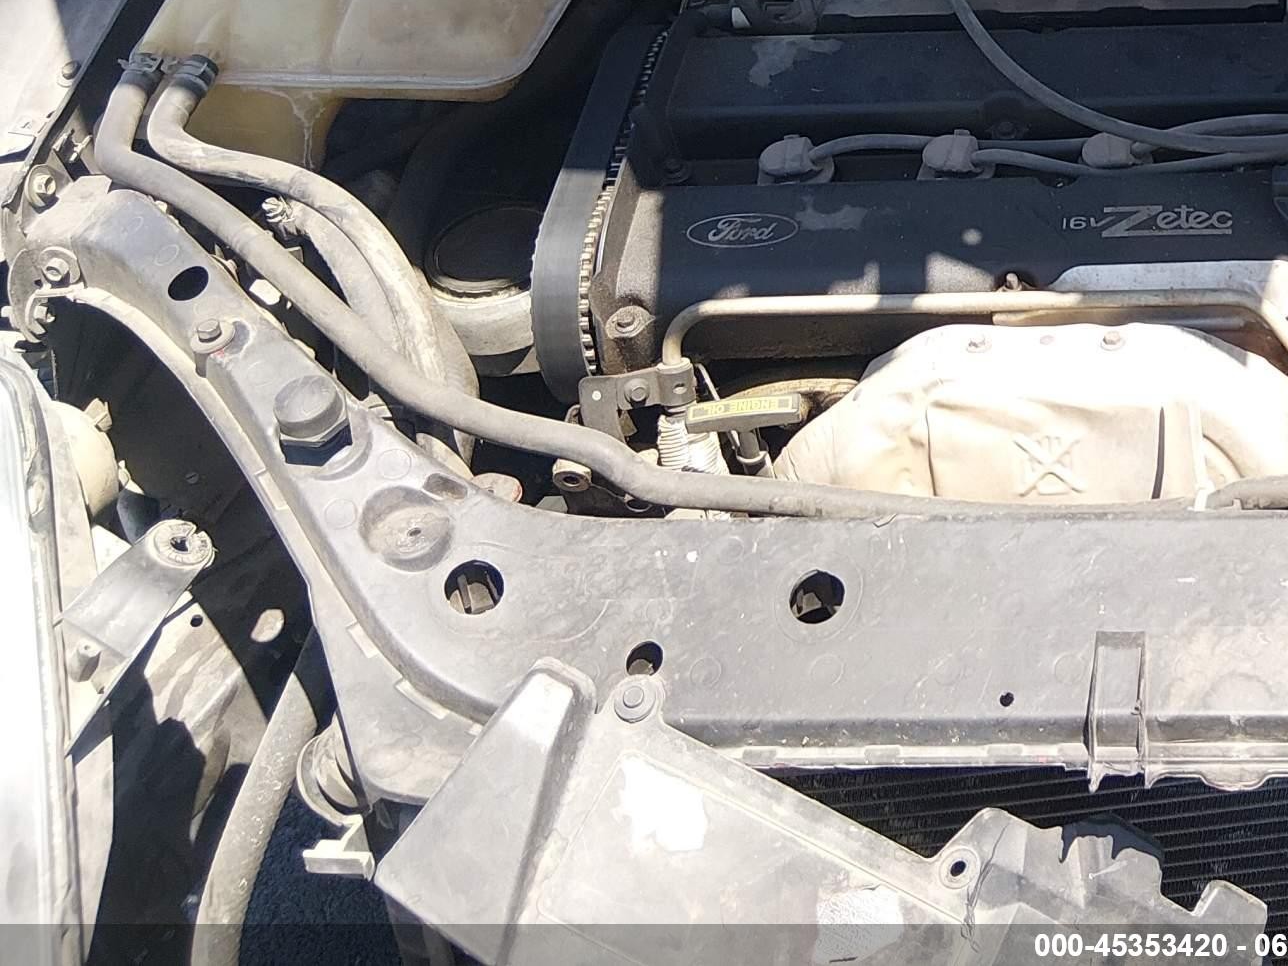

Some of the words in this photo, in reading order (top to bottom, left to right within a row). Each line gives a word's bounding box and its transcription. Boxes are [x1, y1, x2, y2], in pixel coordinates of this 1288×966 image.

[707, 217, 778, 242] Ford
[1062, 215, 1116, 231] 16V
[1102, 204, 1233, 238] Zetec
[704, 403, 725, 415] OIL
[729, 399, 778, 412] ENGINE
